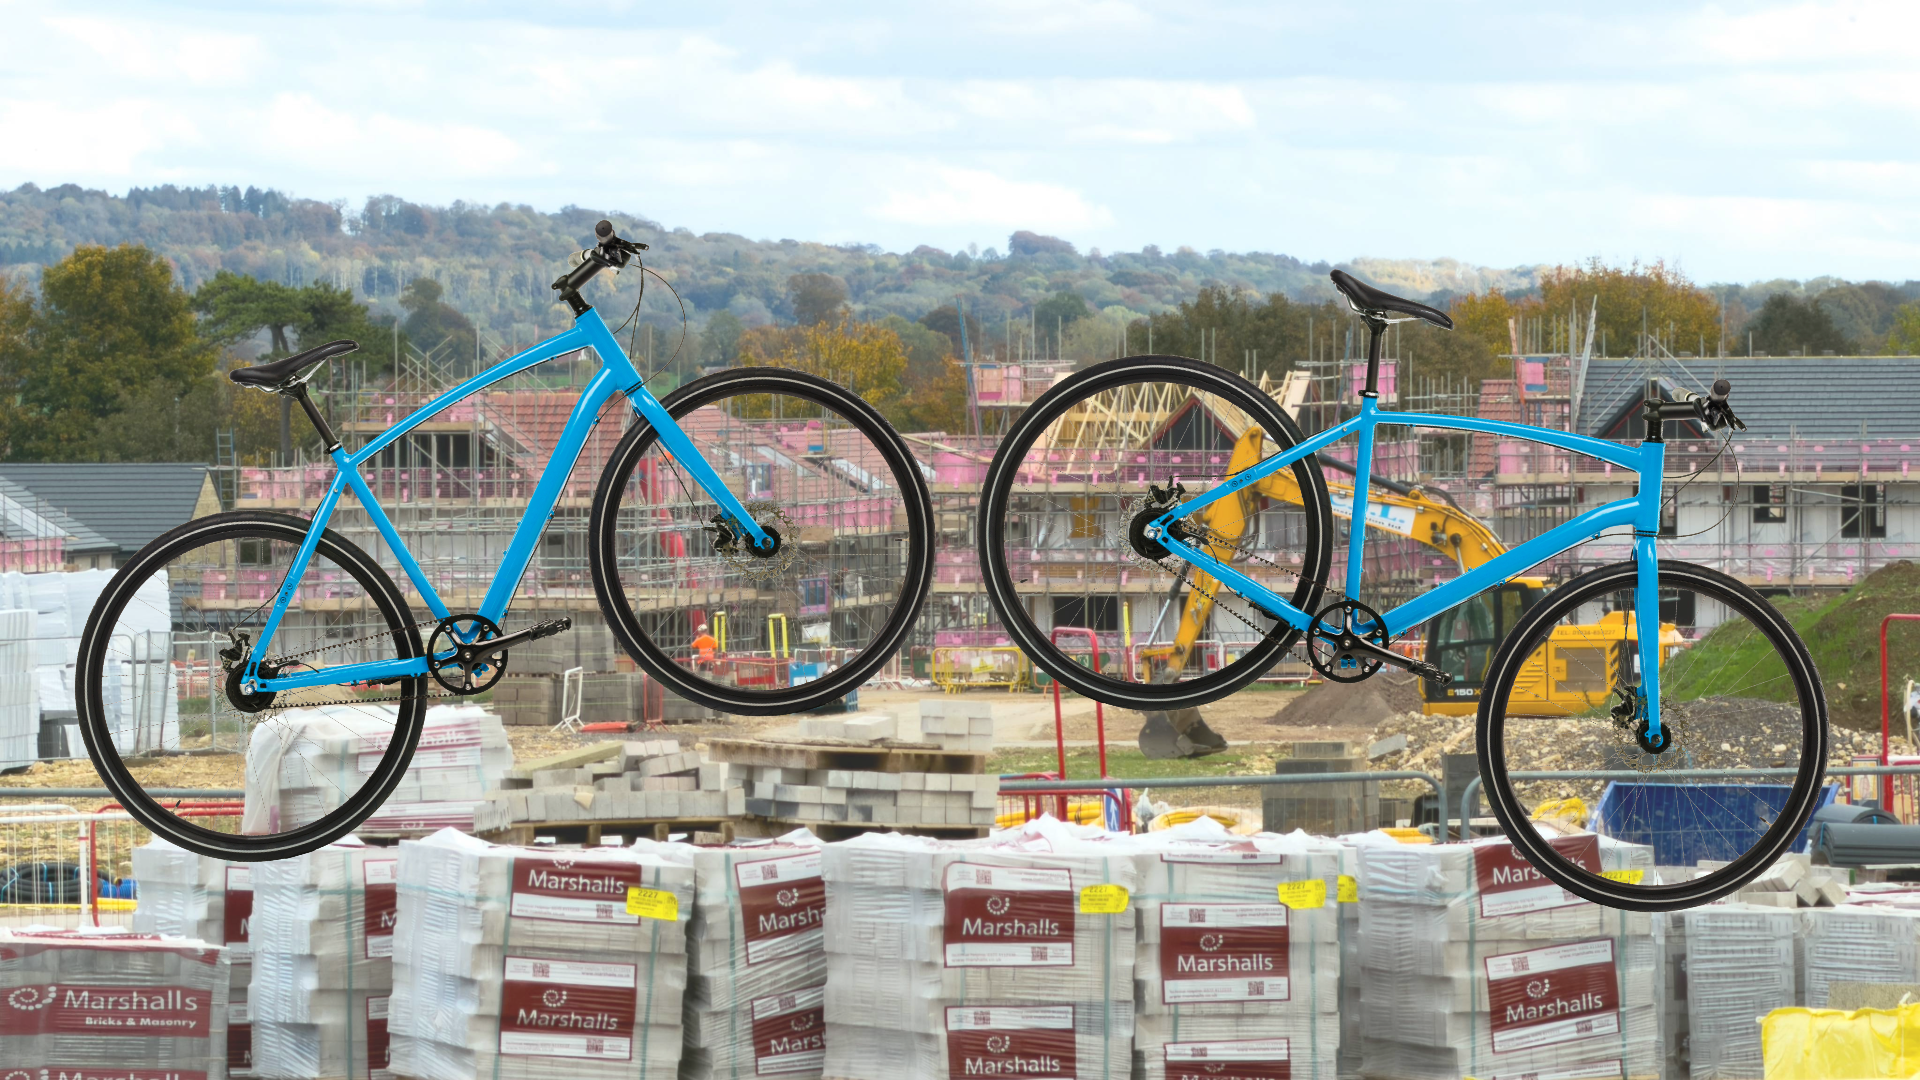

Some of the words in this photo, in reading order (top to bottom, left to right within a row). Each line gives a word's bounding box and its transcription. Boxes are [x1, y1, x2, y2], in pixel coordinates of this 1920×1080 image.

[528, 869, 625, 894] Marshalls
[1089, 885, 1108, 893] 2227
[1286, 882, 1306, 891] 2227
[637, 889, 659, 899] 2227
[962, 917, 1059, 936] Marshalls
[1177, 953, 1273, 972] Marshalls
[63, 990, 198, 1011] Marshalls
[1506, 992, 1603, 1023] Marshalls
[85, 1016, 122, 1026] Bricks
[126, 1017, 136, 1026] &
[140, 1017, 197, 1029] Masonry
[517, 1008, 619, 1030] Marshalls
[965, 1056, 1060, 1075] Marshalls
